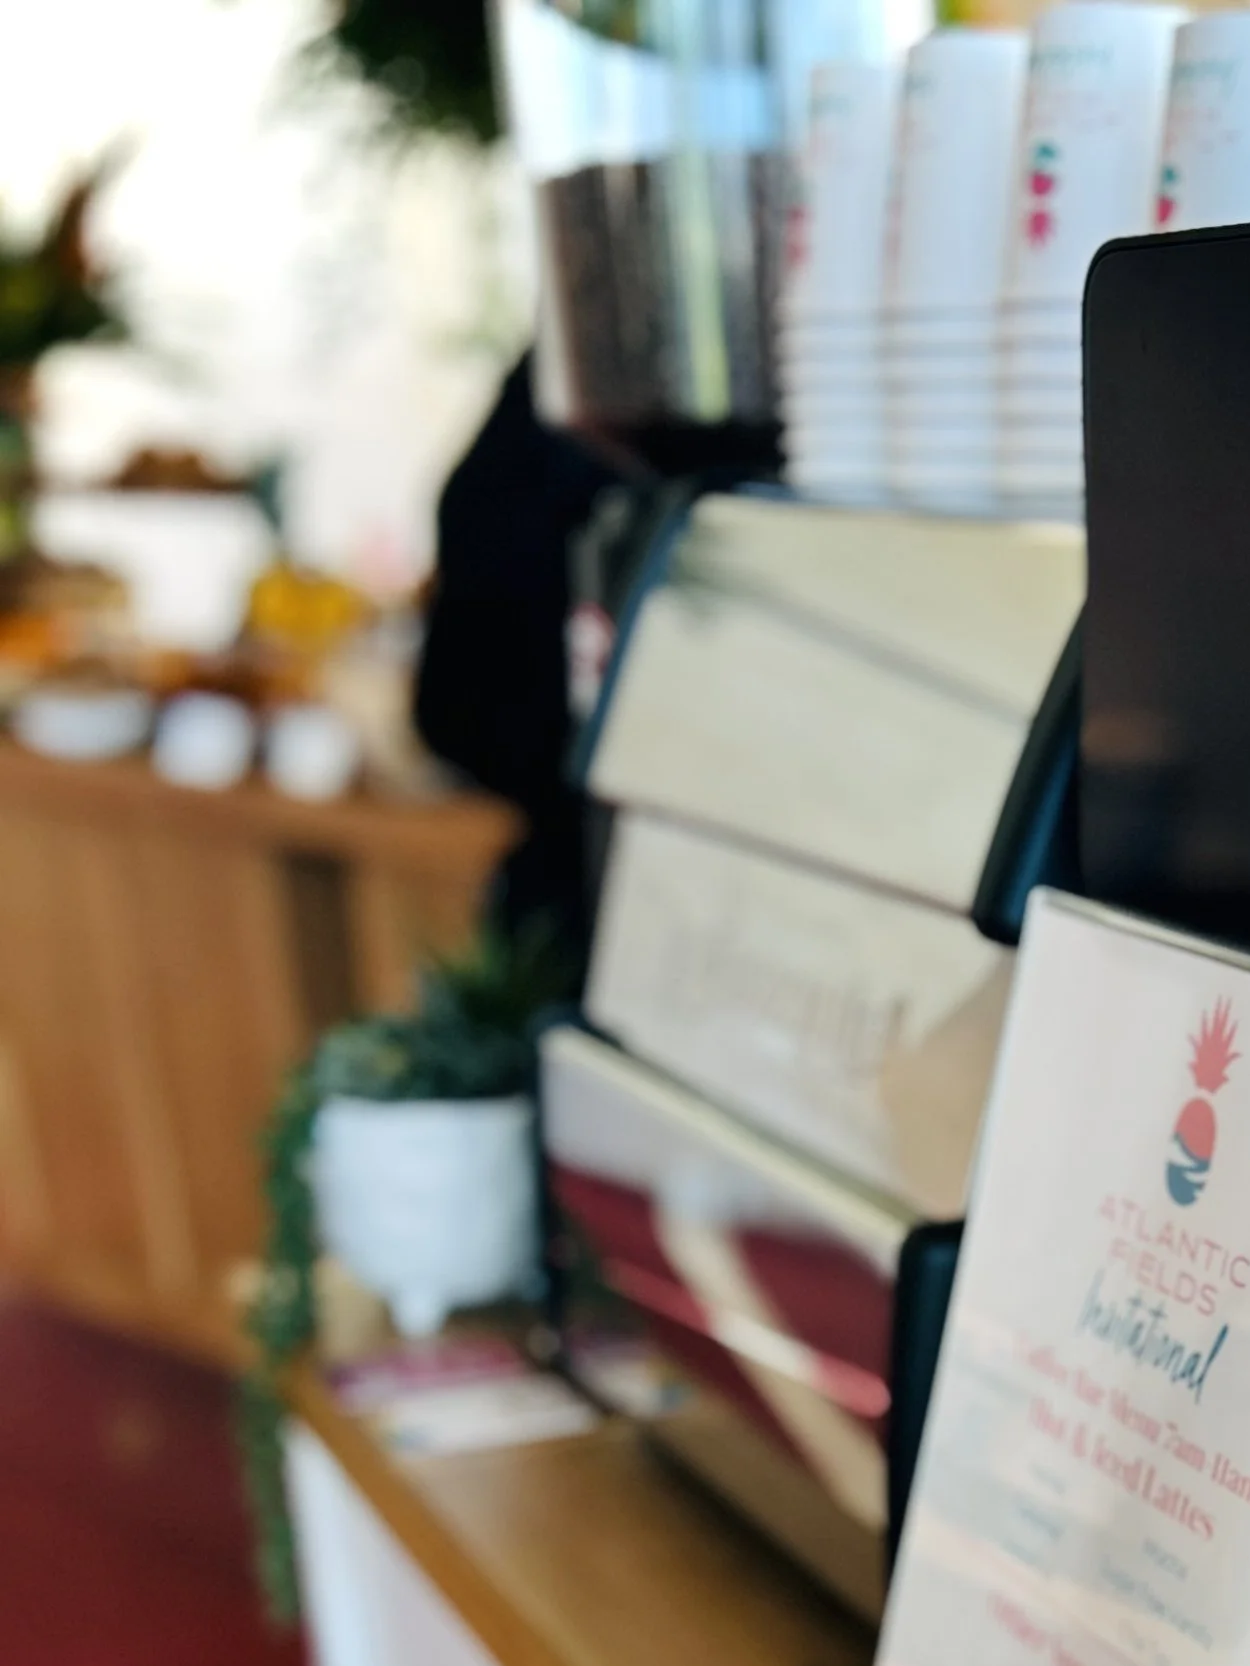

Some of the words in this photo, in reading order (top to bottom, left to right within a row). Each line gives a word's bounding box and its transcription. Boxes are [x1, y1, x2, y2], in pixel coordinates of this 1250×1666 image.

[1109, 1236, 1218, 1317] FIELDS
[1077, 1266, 1229, 1405] Invitational
[1140, 1462, 1215, 1542] Lattes
